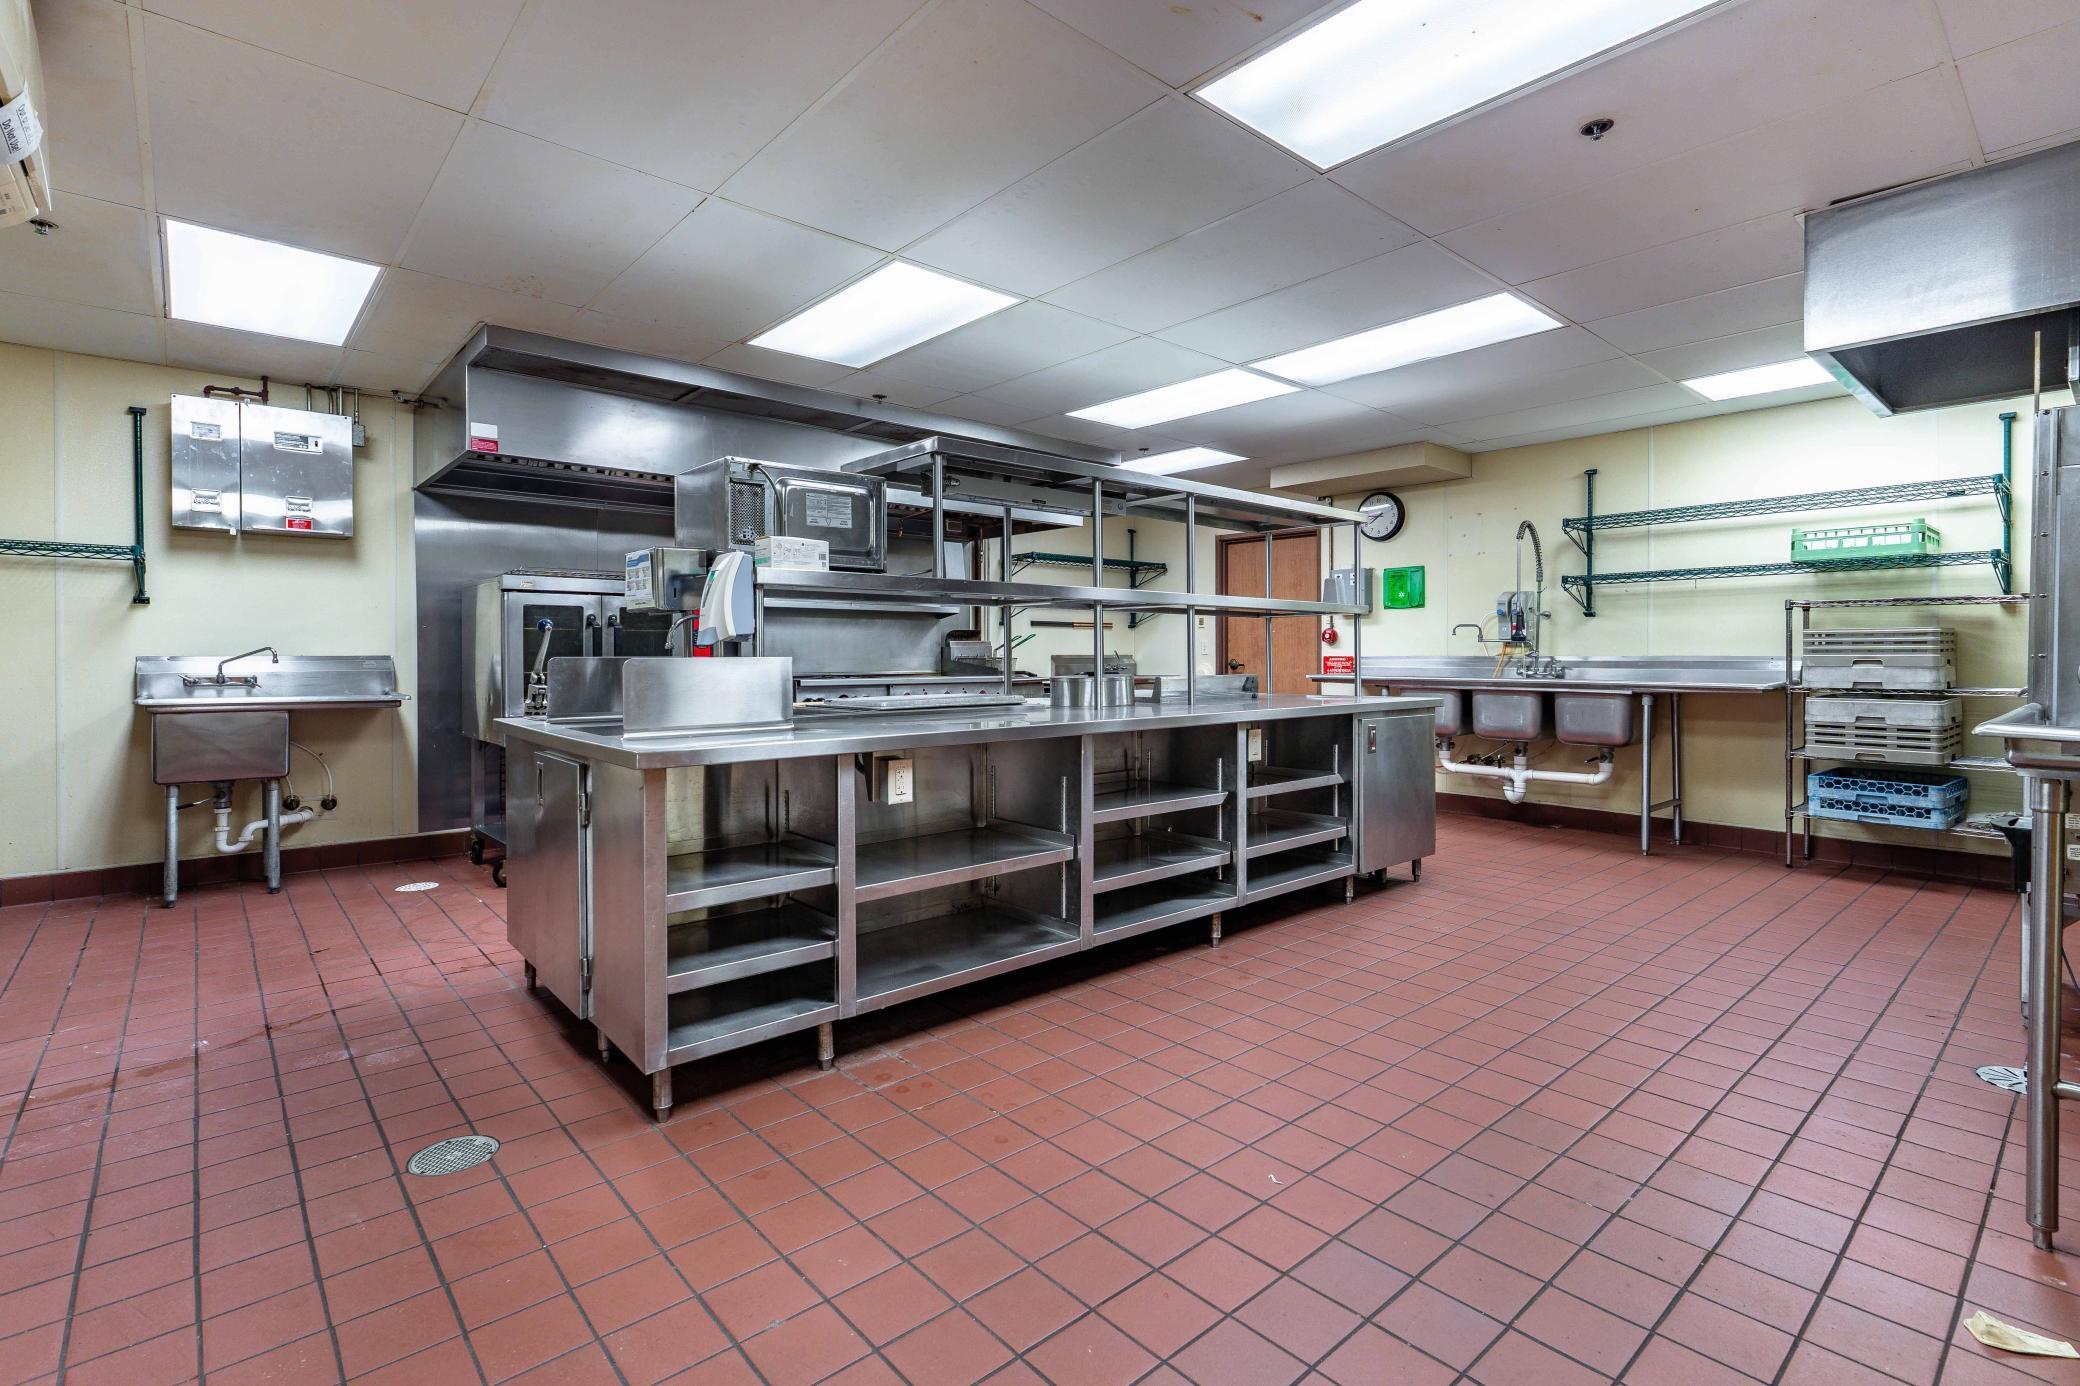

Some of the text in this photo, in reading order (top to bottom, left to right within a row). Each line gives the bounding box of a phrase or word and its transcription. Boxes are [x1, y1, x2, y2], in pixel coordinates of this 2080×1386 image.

[2, 119, 22, 153] Do Not Use!
